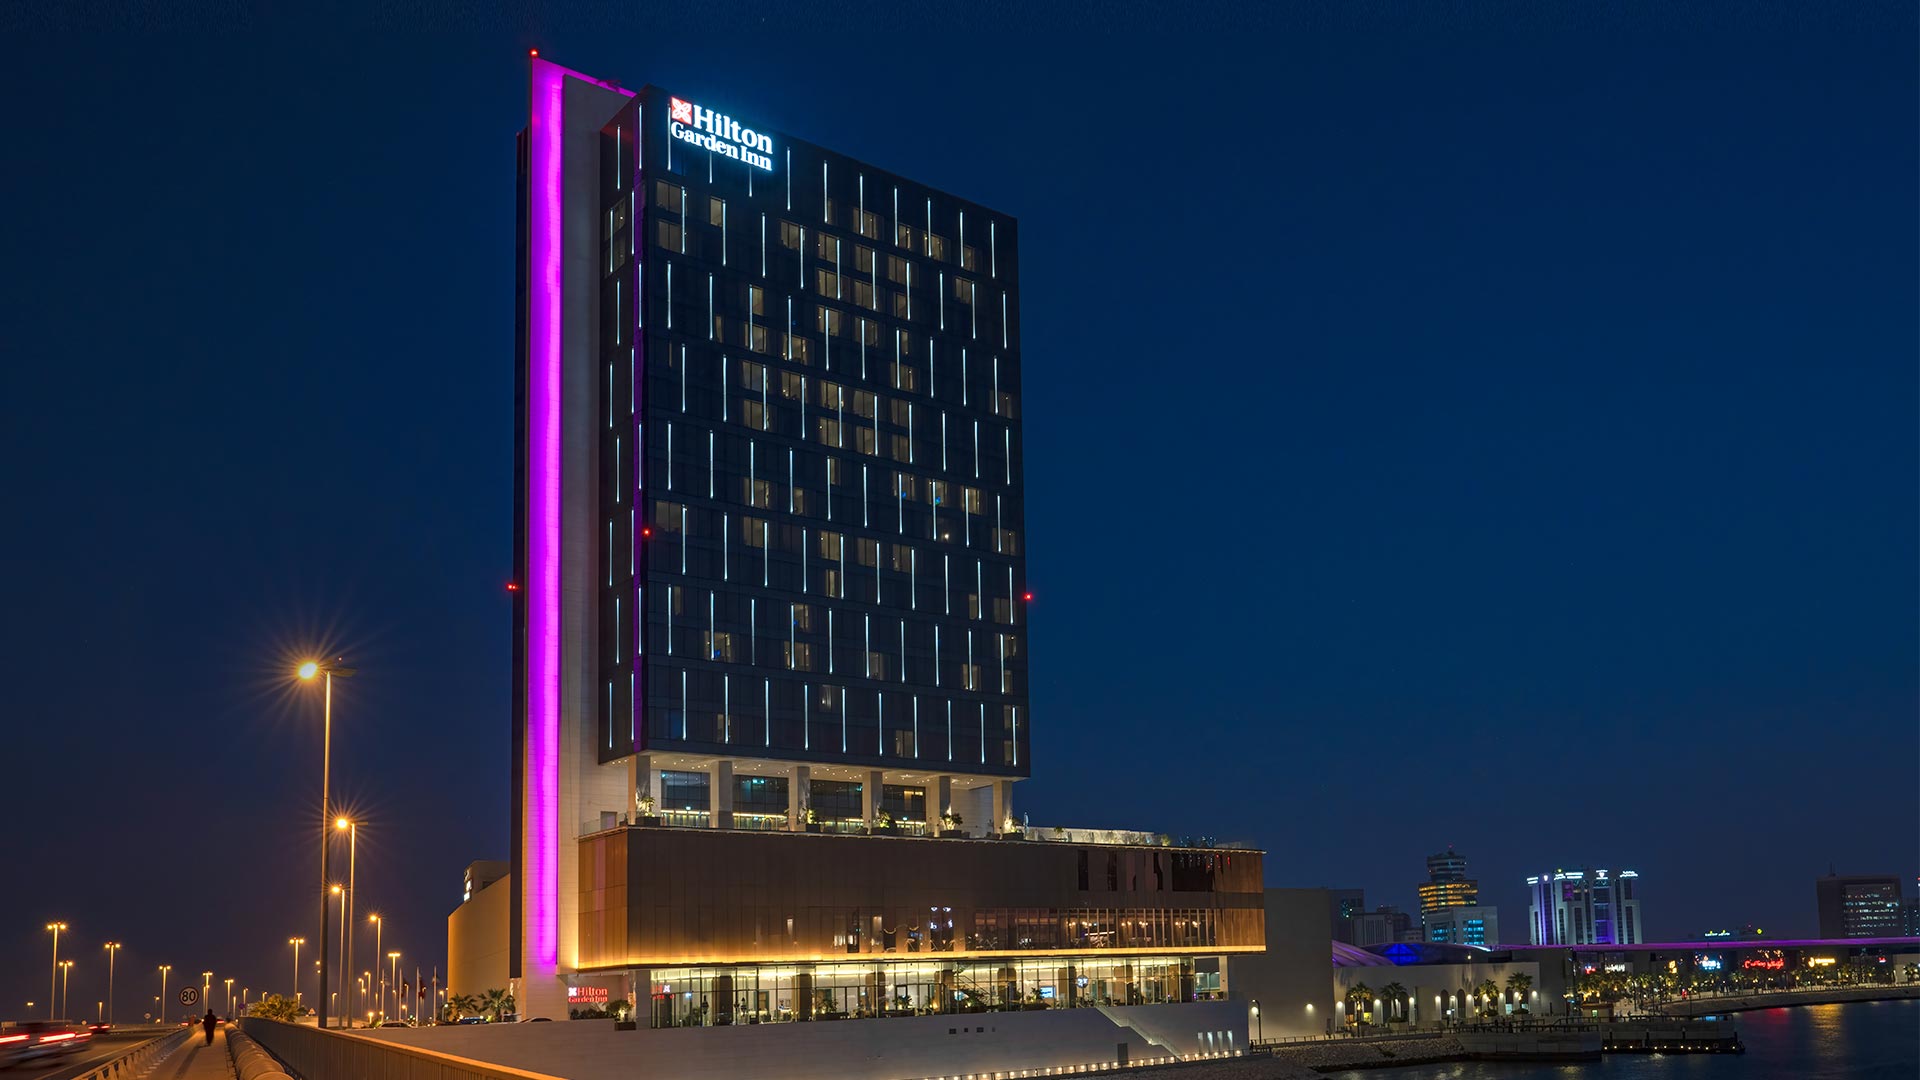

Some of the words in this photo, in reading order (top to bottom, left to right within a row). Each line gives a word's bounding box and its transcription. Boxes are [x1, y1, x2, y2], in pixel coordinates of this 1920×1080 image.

[693, 104, 773, 154] Hilton
[670, 121, 739, 160] Garden
[740, 145, 773, 171] Inn
[182, 990, 196, 1002] 80
[577, 986, 608, 996] Hilton
[568, 995, 595, 1003] Garden
[595, 995, 608, 1003] Inn
